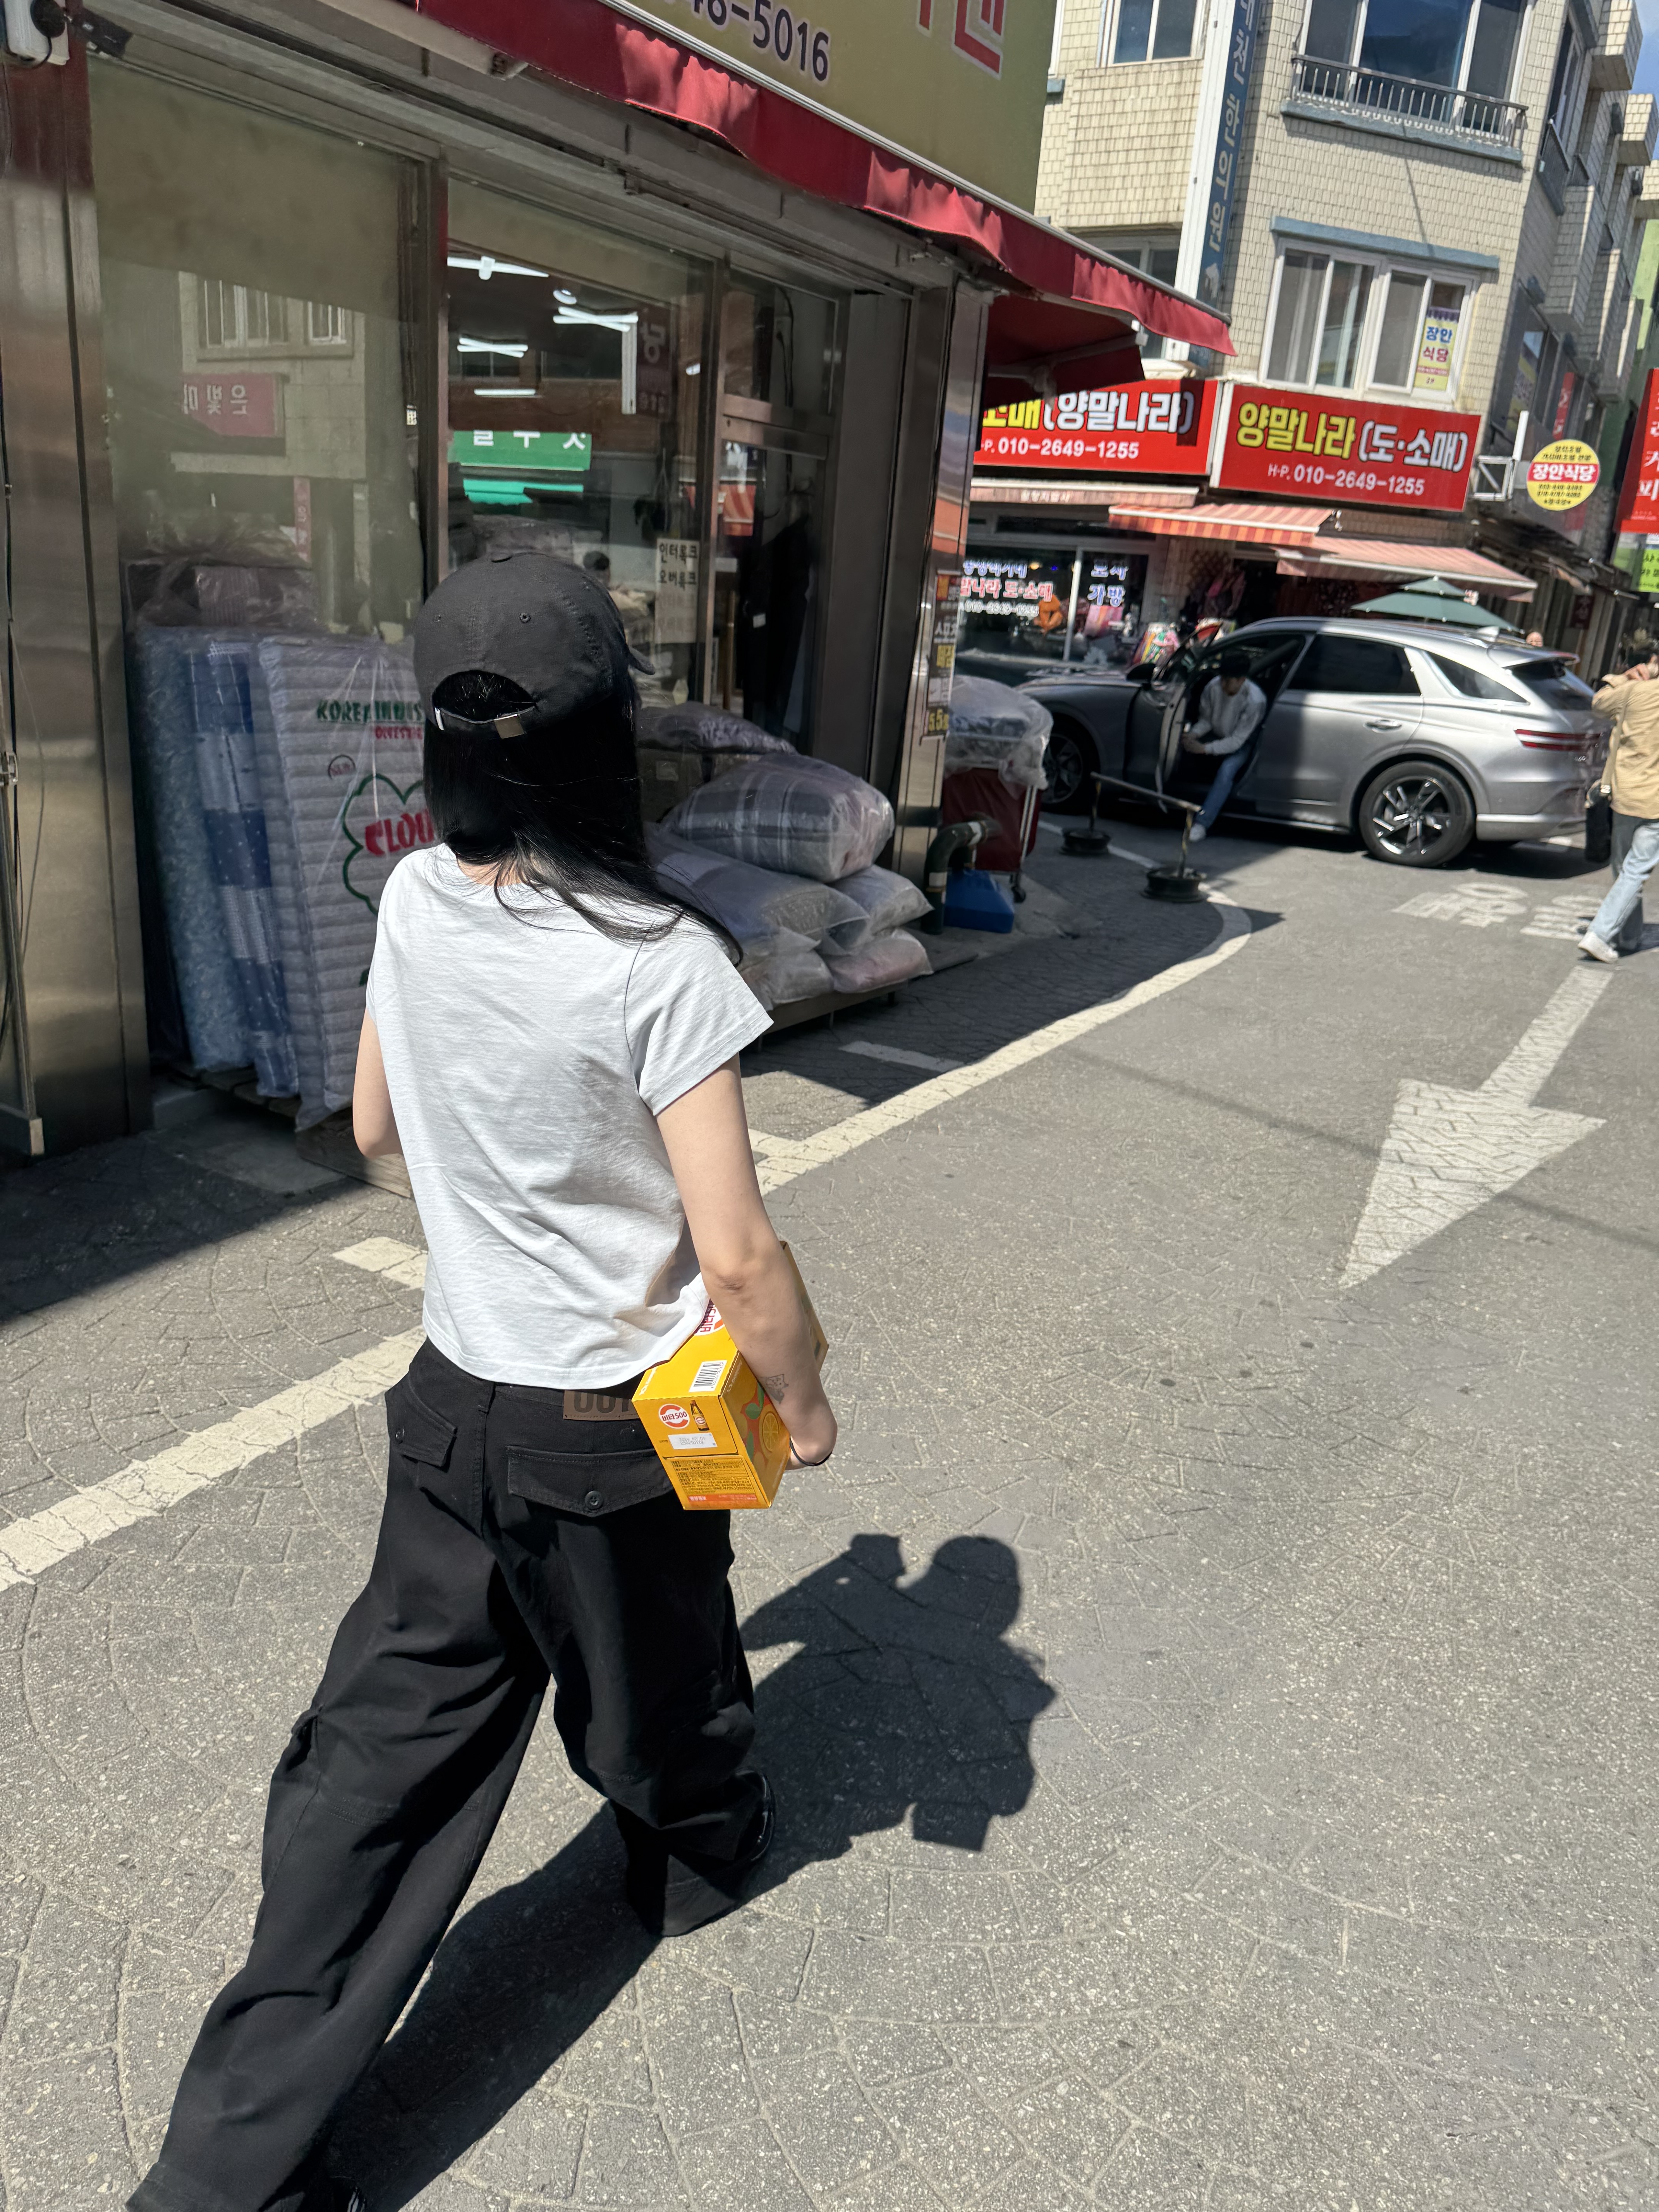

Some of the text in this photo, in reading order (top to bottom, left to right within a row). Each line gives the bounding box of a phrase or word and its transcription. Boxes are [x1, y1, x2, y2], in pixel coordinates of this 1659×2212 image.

[1423, 347, 1449, 362] 식당
[998, 437, 1140, 459] 010-2649-1255
[1294, 464, 1425, 496] 010-2649-1255
[1533, 464, 1596, 481] 장안식당
[1087, 583, 1127, 608] 가방
